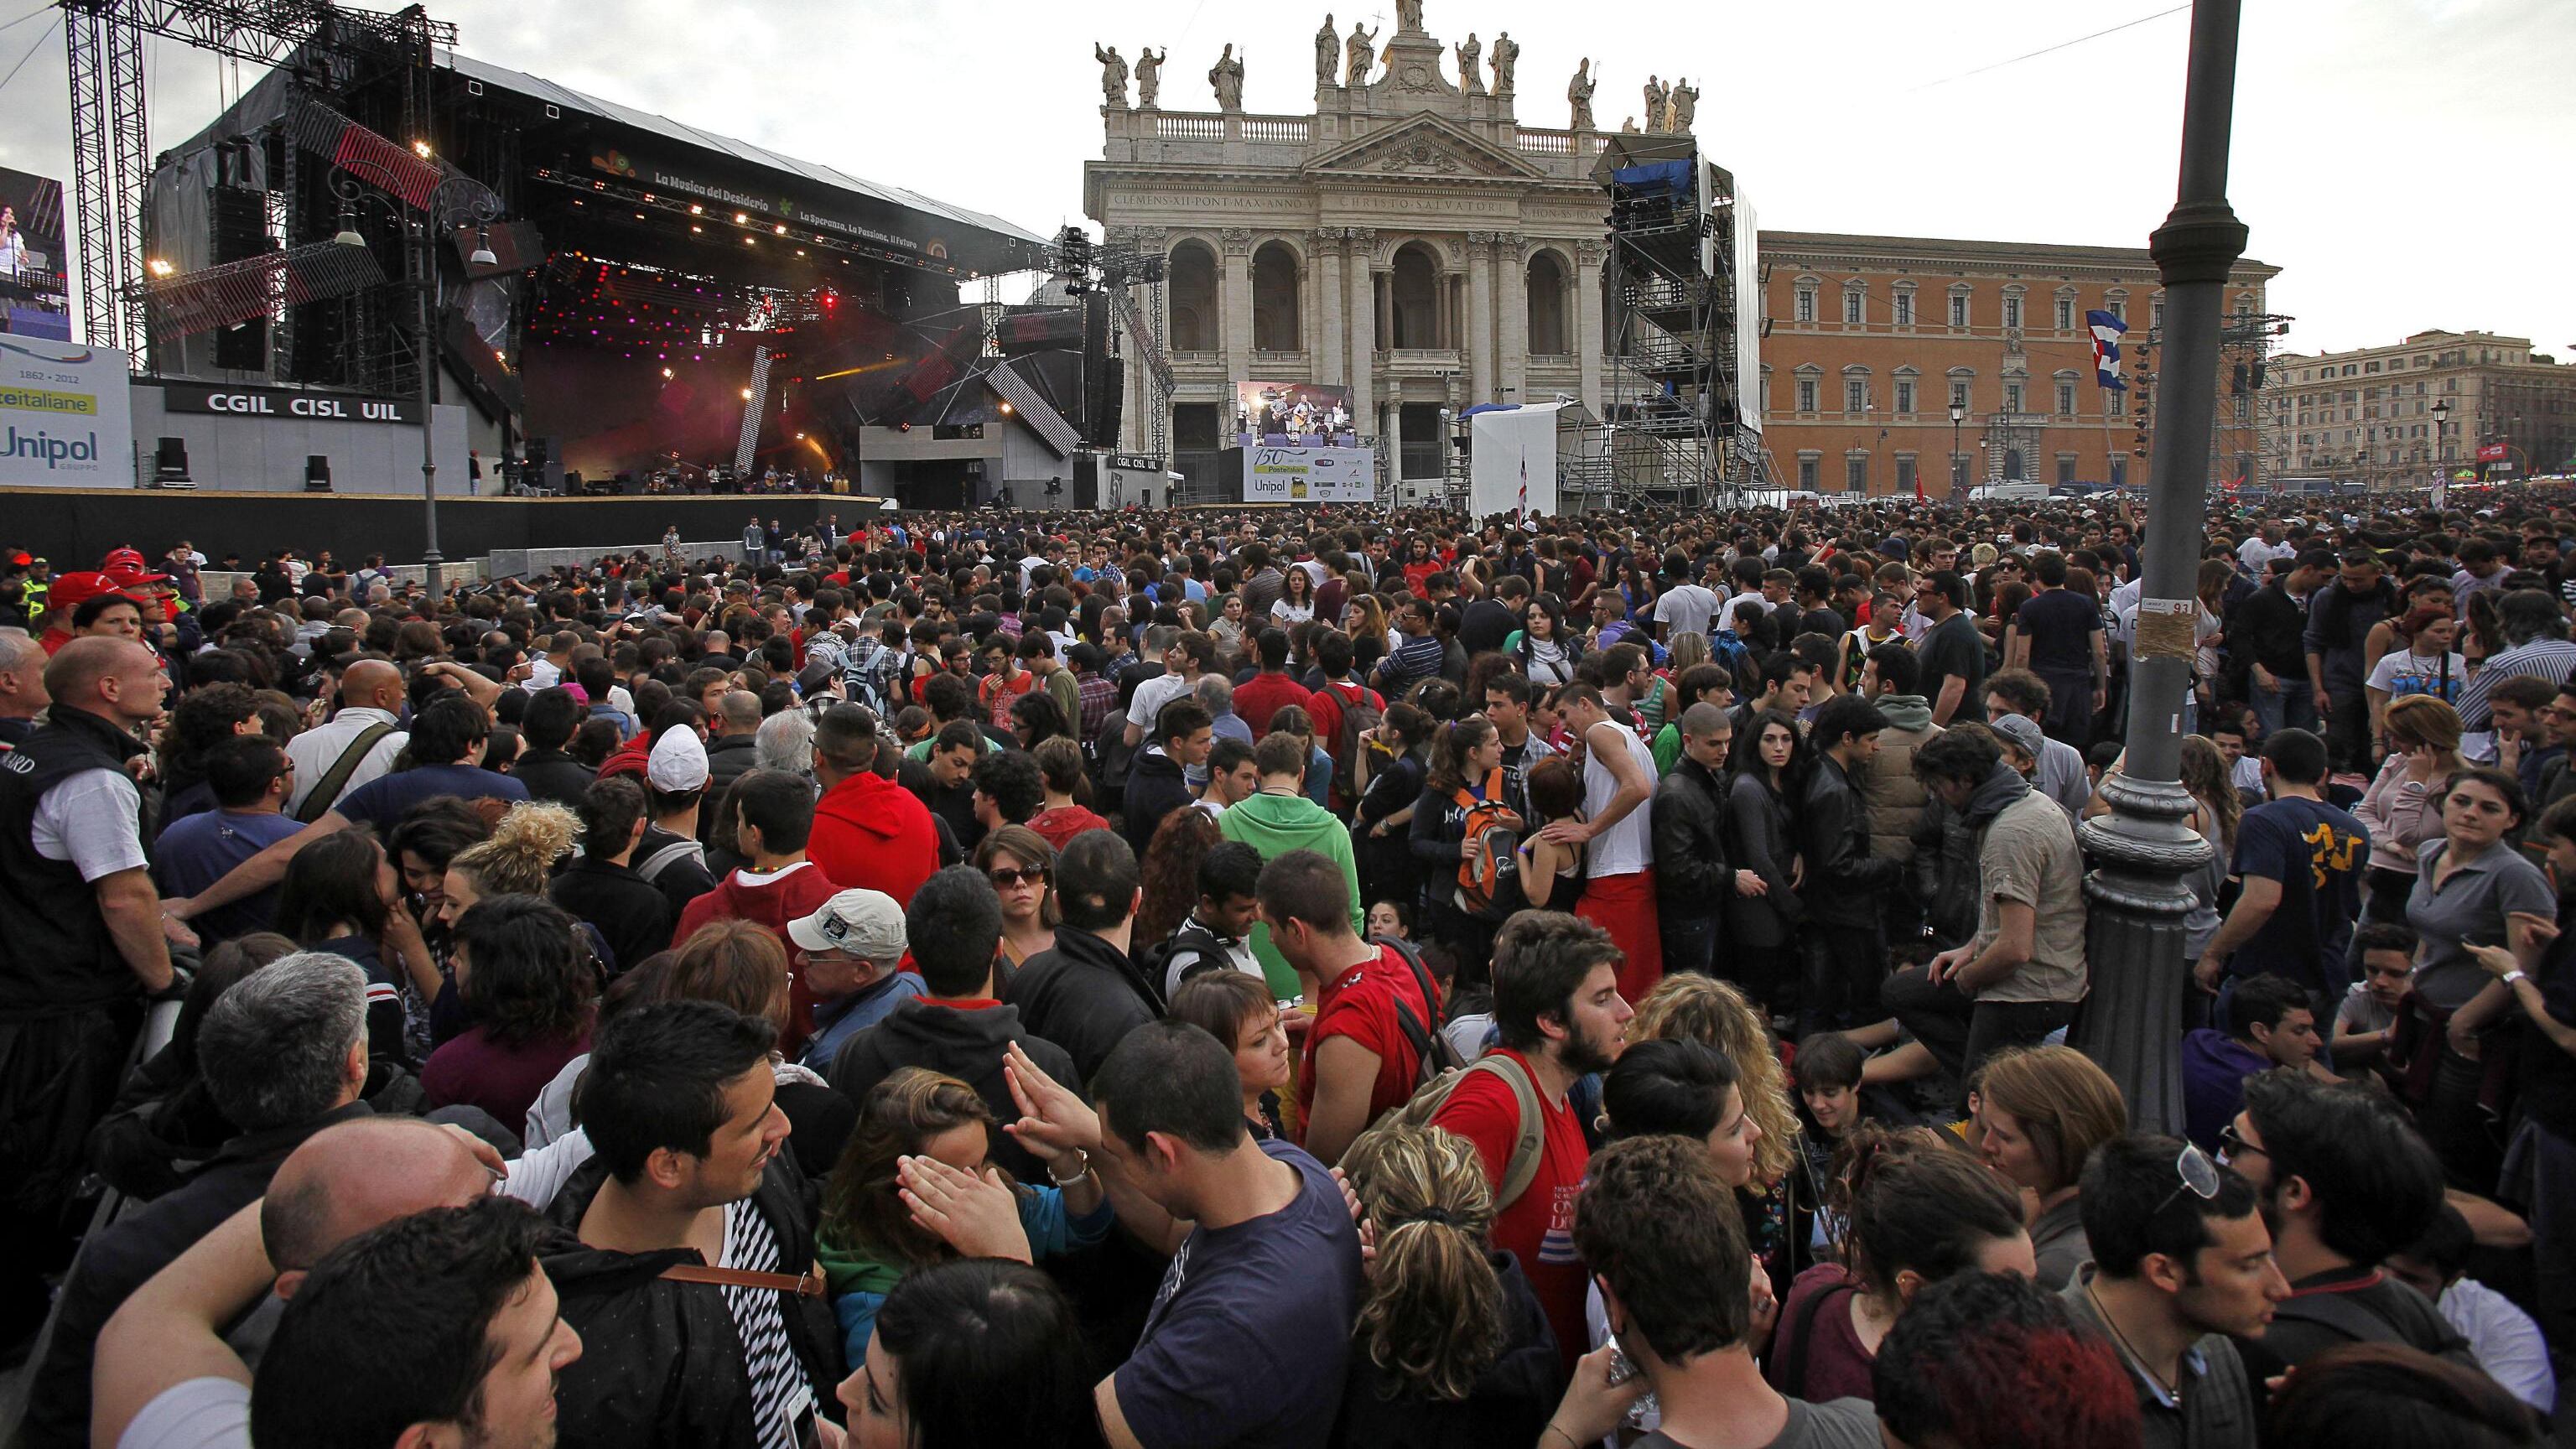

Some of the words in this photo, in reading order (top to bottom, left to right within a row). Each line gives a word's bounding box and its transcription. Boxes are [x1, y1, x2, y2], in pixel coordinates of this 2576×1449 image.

[655, 172, 668, 185] La
[671, 176, 706, 195] Musica
[707, 186, 722, 200] del
[724, 190, 769, 211] Desiderio
[1114, 194, 1168, 205] CLEMENS
[1174, 195, 1191, 205] XII
[1195, 196, 1229, 206] PONT
[1233, 198, 1261, 208] MAX
[1268, 198, 1302, 209] ANNO
[1341, 196, 1409, 209] CHRISTO
[1416, 200, 1504, 212] SALVATORI
[800, 211, 809, 221] La
[810, 214, 847, 232] Speranza,
[849, 224, 857, 234] La
[858, 226, 889, 244] Passione,
[896, 236, 917, 249] Futuro
[19, 370, 44, 381] 1862
[55, 374, 80, 384] 2012
[208, 393, 274, 413] CGIL
[290, 398, 347, 418] CISL
[362, 402, 402, 420] UIL
[1117, 457, 1130, 467] CGIL
[1133, 459, 1145, 468] CISL
[1147, 460, 1156, 470] UIL
[1254, 479, 1285, 495] Unipol
